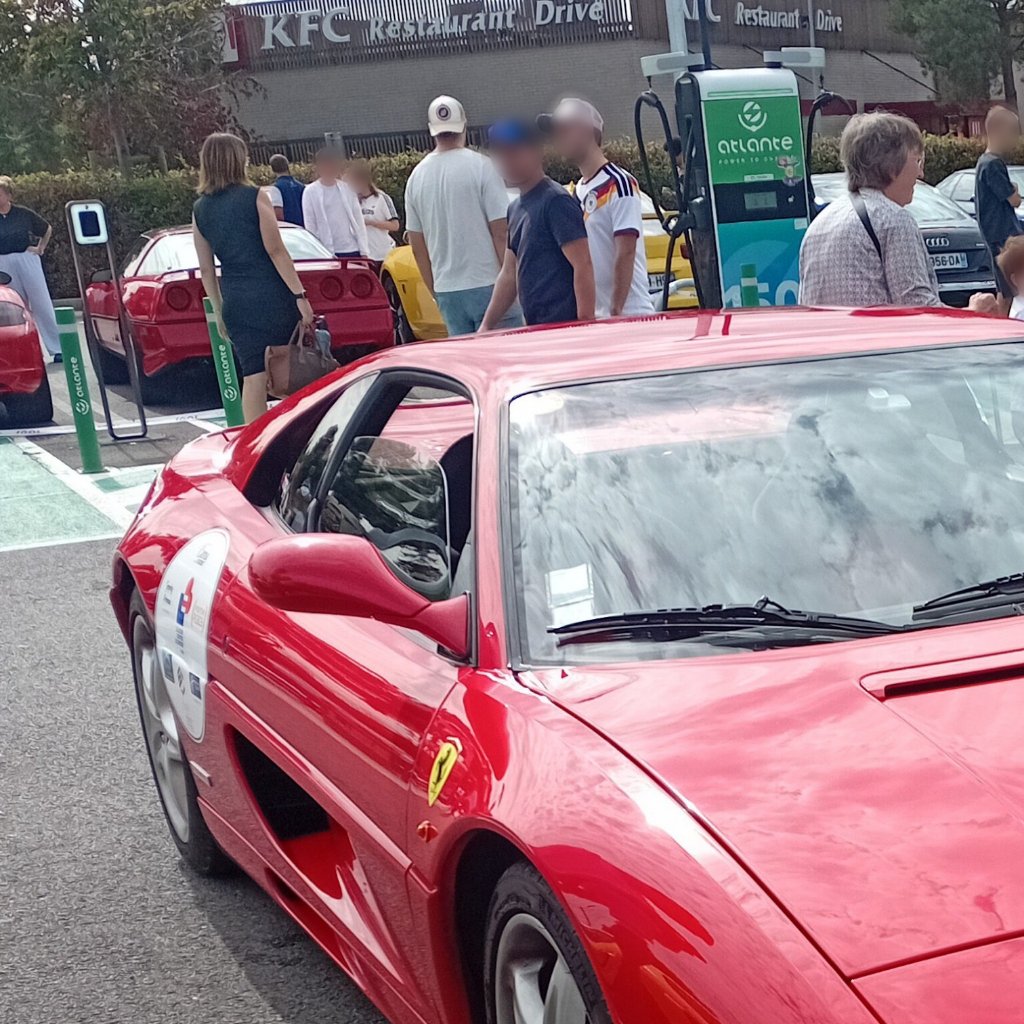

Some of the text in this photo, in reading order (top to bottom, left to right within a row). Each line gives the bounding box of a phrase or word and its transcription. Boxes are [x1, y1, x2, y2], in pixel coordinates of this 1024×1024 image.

[261, 0, 604, 50] KFC Restaurant Drive
[735, 2, 800, 29] Restaurant
[816, 9, 842, 32] Drive
[717, 136, 794, 154] atlante
[70, 356, 84, 398] atlante
[218, 344, 232, 385] atlante
